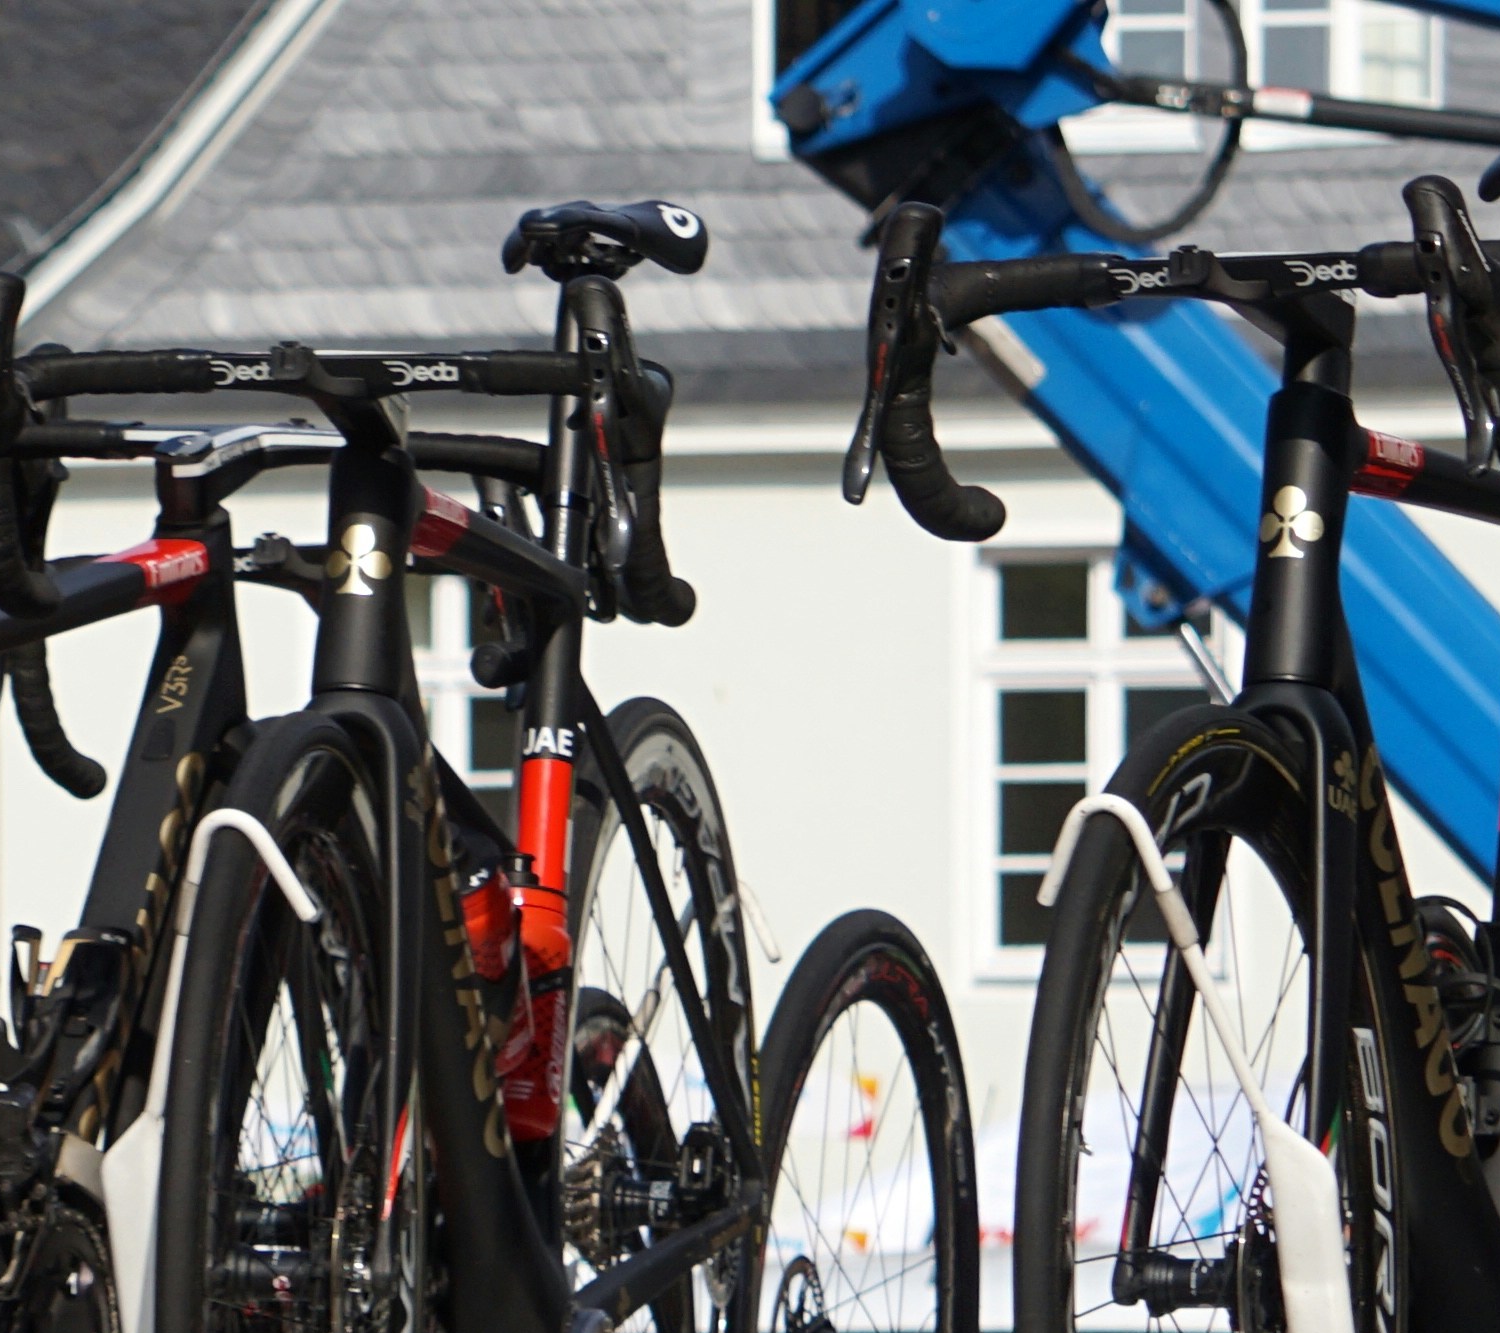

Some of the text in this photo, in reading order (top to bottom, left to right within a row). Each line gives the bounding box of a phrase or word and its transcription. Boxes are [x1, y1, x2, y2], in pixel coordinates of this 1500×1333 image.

[1109, 267, 1171, 295] Ded
[210, 359, 270, 387] Ded
[382, 360, 460, 387] Deda
